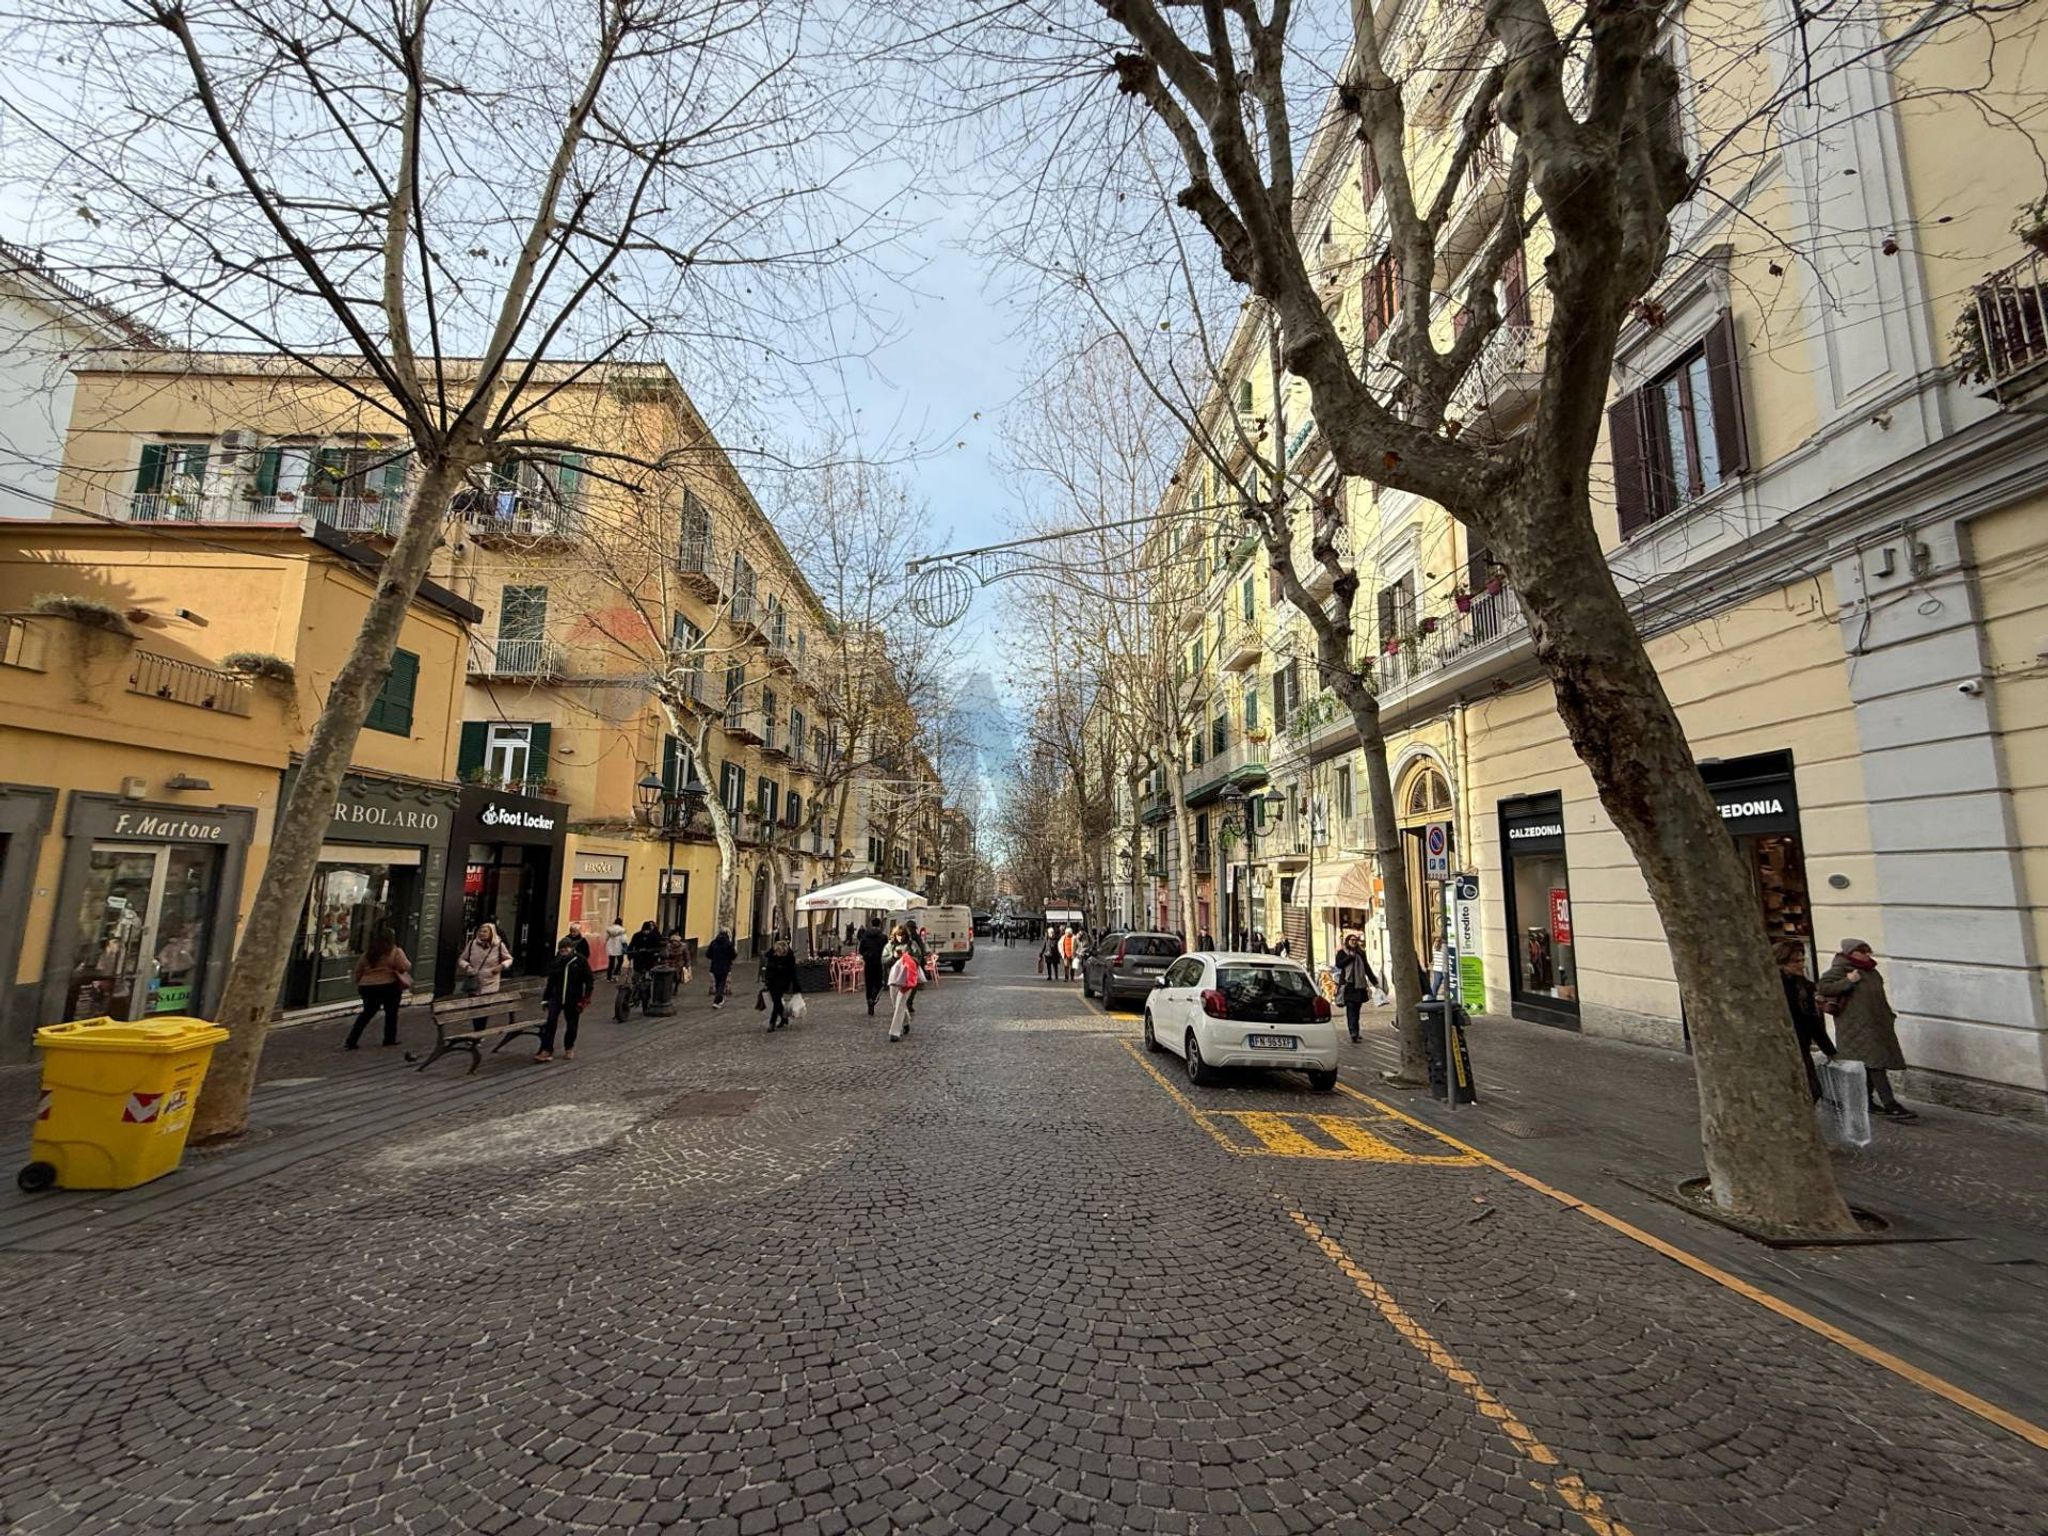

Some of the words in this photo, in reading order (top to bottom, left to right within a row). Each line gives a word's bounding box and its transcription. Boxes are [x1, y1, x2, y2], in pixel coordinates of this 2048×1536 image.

[334, 802, 438, 829] RBOLARIO
[499, 808, 521, 826] Foot
[523, 812, 554, 830] Locker
[1716, 799, 1783, 818] EDONIA
[1509, 824, 1562, 839] CALZEDONIA
[1461, 906, 1472, 949] incredito
